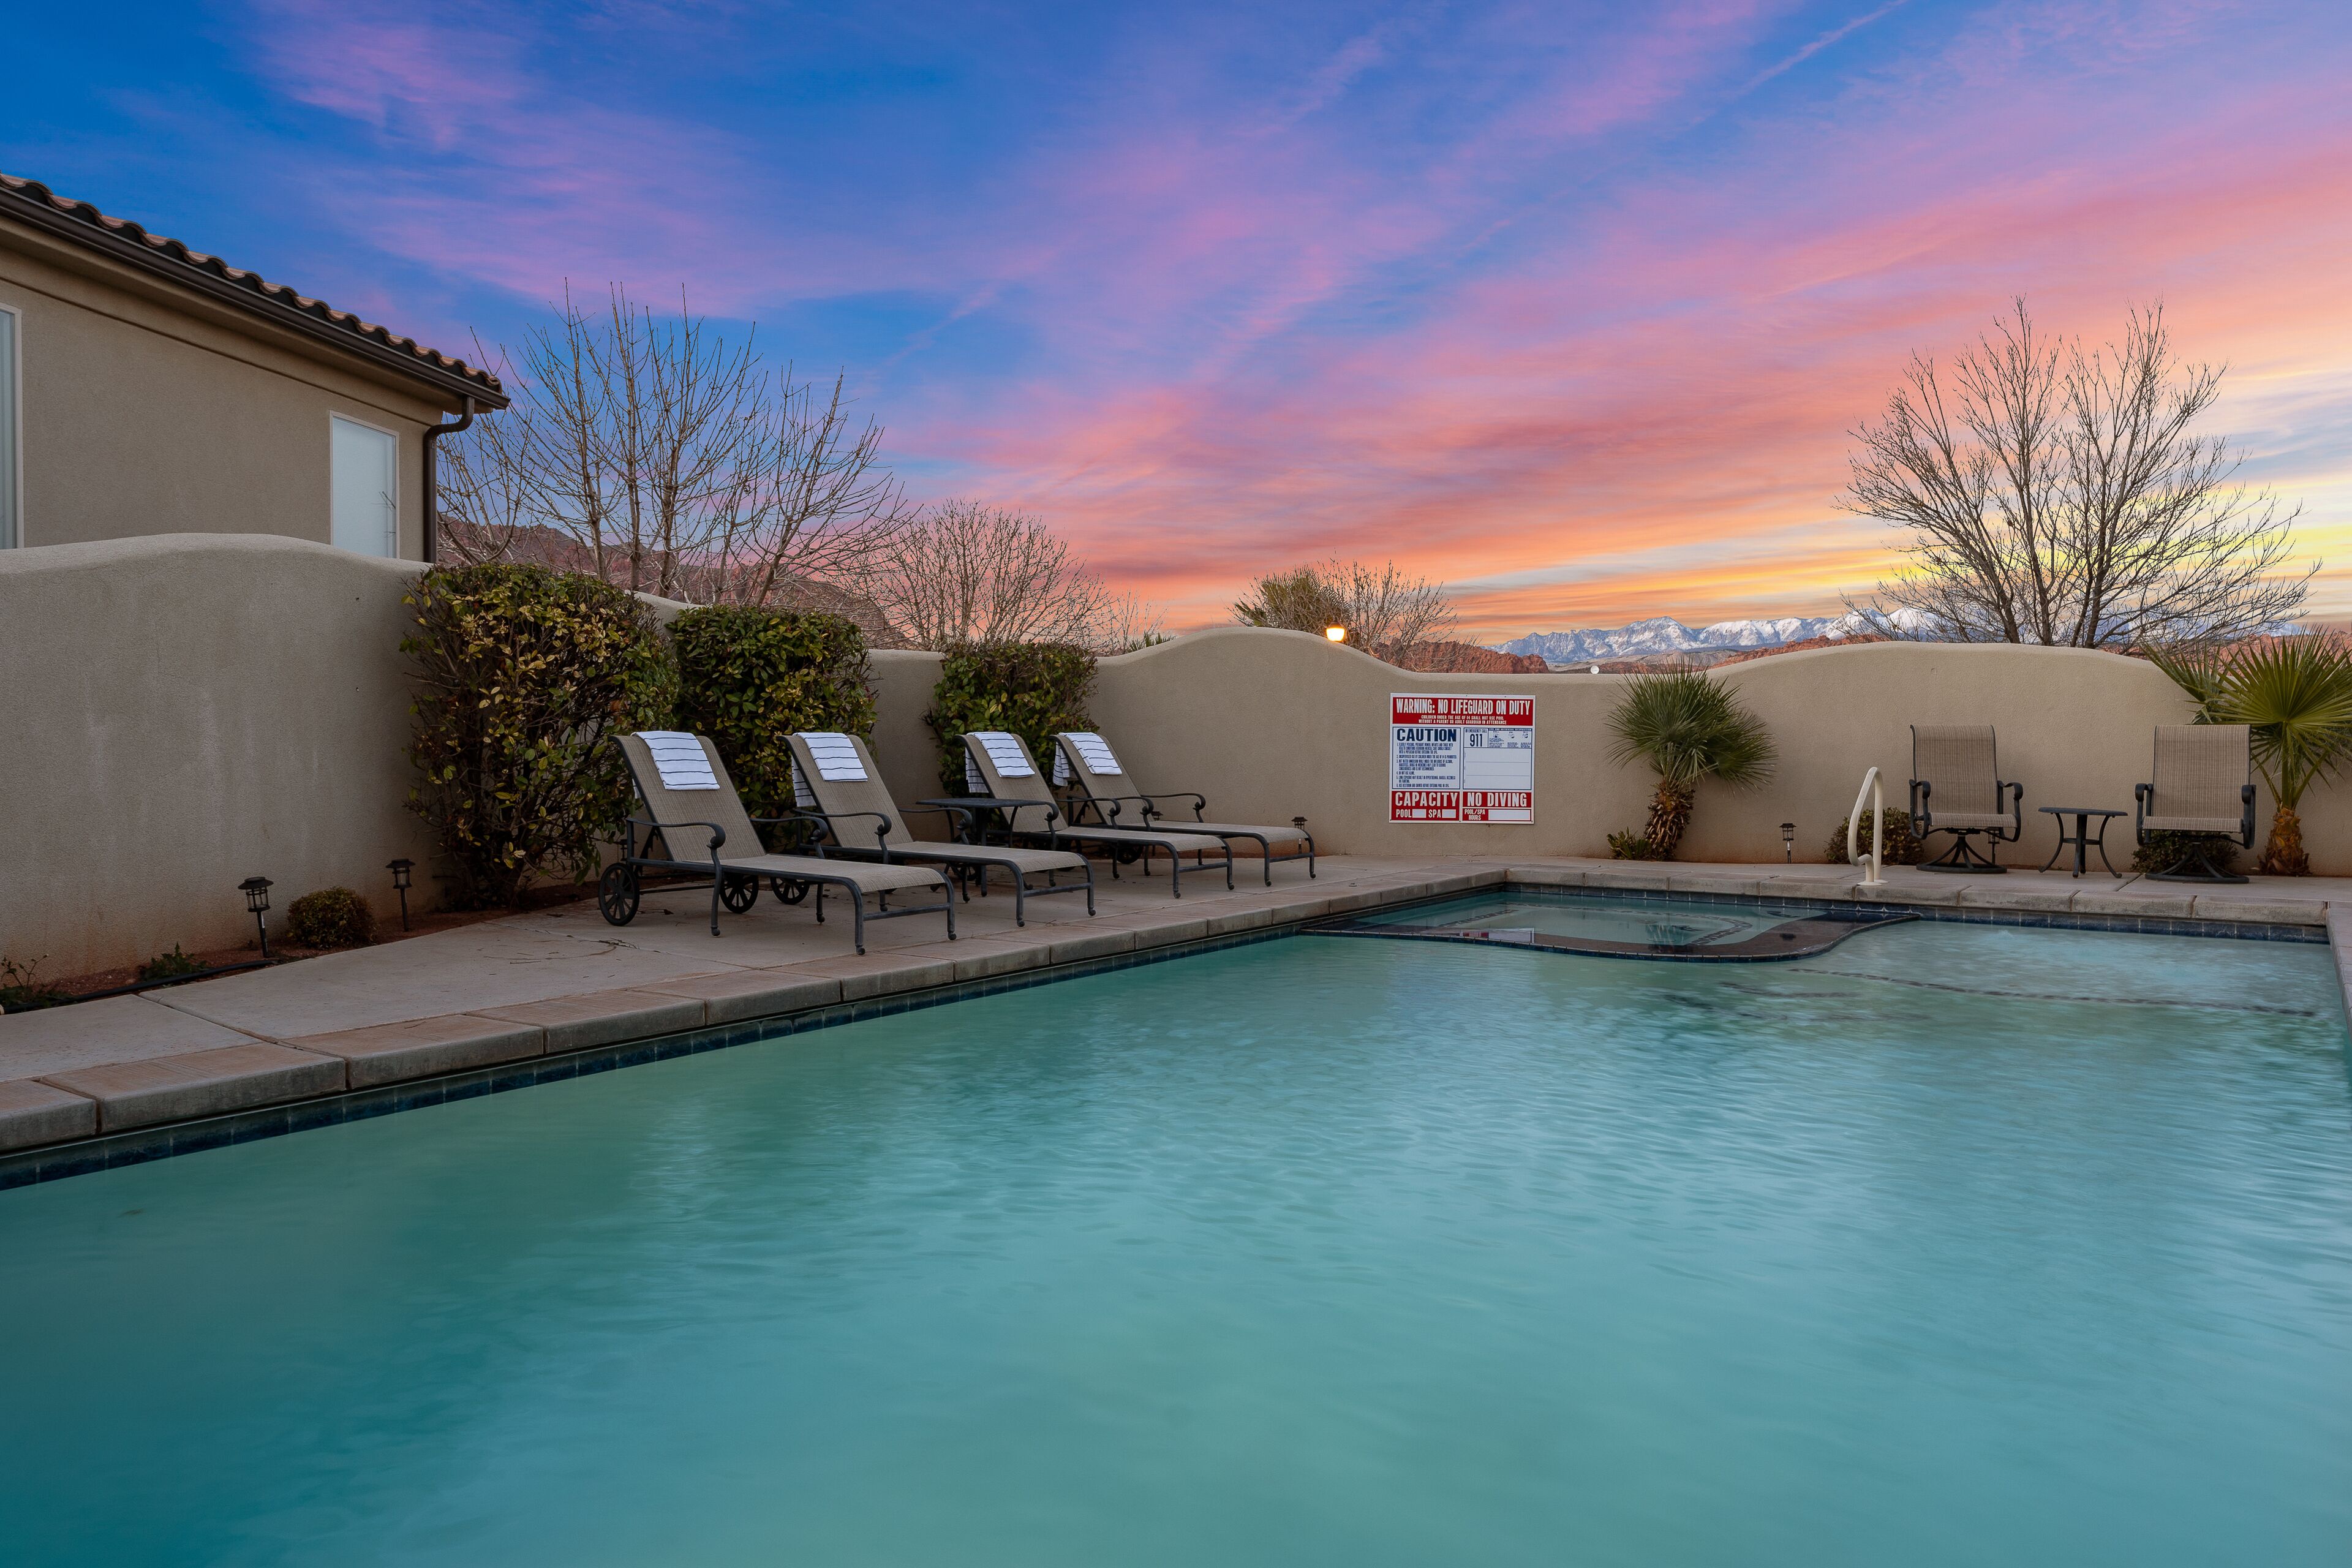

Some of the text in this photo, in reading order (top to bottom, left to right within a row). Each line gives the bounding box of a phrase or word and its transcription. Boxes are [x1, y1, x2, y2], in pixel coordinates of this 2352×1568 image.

[1396, 699, 1530, 715] WARNING: NO LIFEGUARD ON DUTY
[1397, 728, 1457, 742] CAUTION
[1470, 734, 1482, 747] 911
[1395, 792, 1458, 806] CAPACITY
[1468, 793, 1526, 807] NO DIVING
[1396, 809, 1441, 818] POOL SPA
